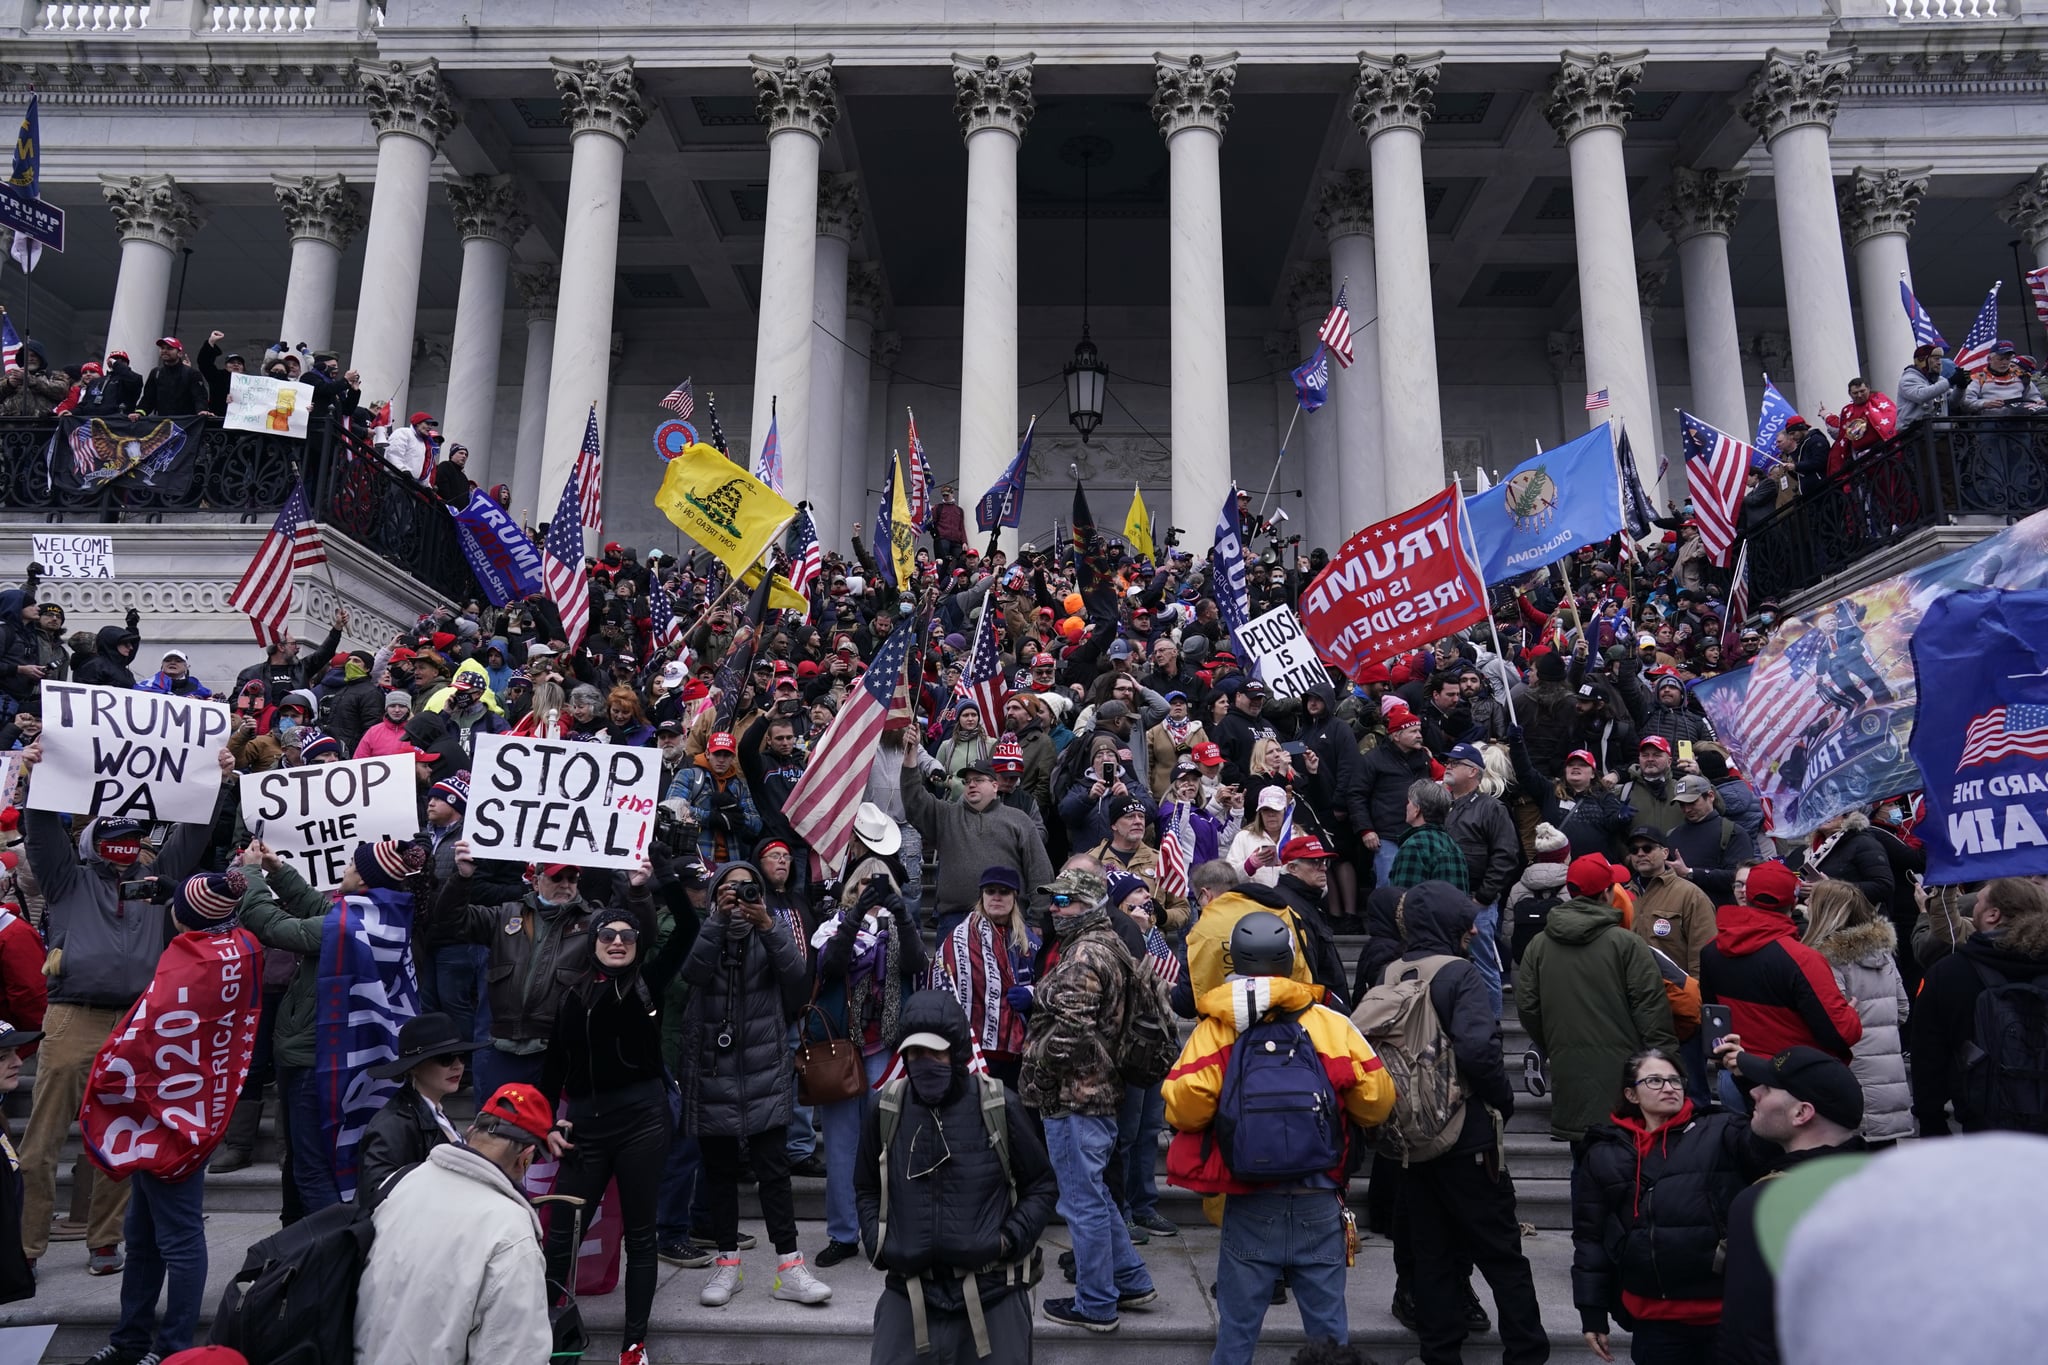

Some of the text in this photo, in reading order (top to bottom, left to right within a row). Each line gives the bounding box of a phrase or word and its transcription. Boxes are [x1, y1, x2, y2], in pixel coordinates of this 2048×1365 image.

[0, 193, 60, 226] TRUMP
[4, 205, 54, 232] PENCE
[33, 536, 112, 554] WELCOME
[39, 552, 105, 566] TO THE
[470, 495, 543, 585] TRUMP
[474, 549, 509, 601] BULLSHIT
[1241, 610, 1301, 658] PELOSI
[1273, 657, 1328, 698] SATAN
[1276, 648, 1294, 668] IS
[46, 685, 227, 748] TRUMP
[92, 736, 189, 783] WON
[491, 742, 644, 806] STOP
[88, 779, 158, 820] PA
[259, 761, 391, 821] STOP
[617, 795, 653, 815] the
[295, 813, 357, 846] THE
[472, 798, 647, 860] STEAL!
[989, 986, 1000, 1010] But
[983, 1014, 998, 1048] They
[155, 987, 207, 1145] -2020-
